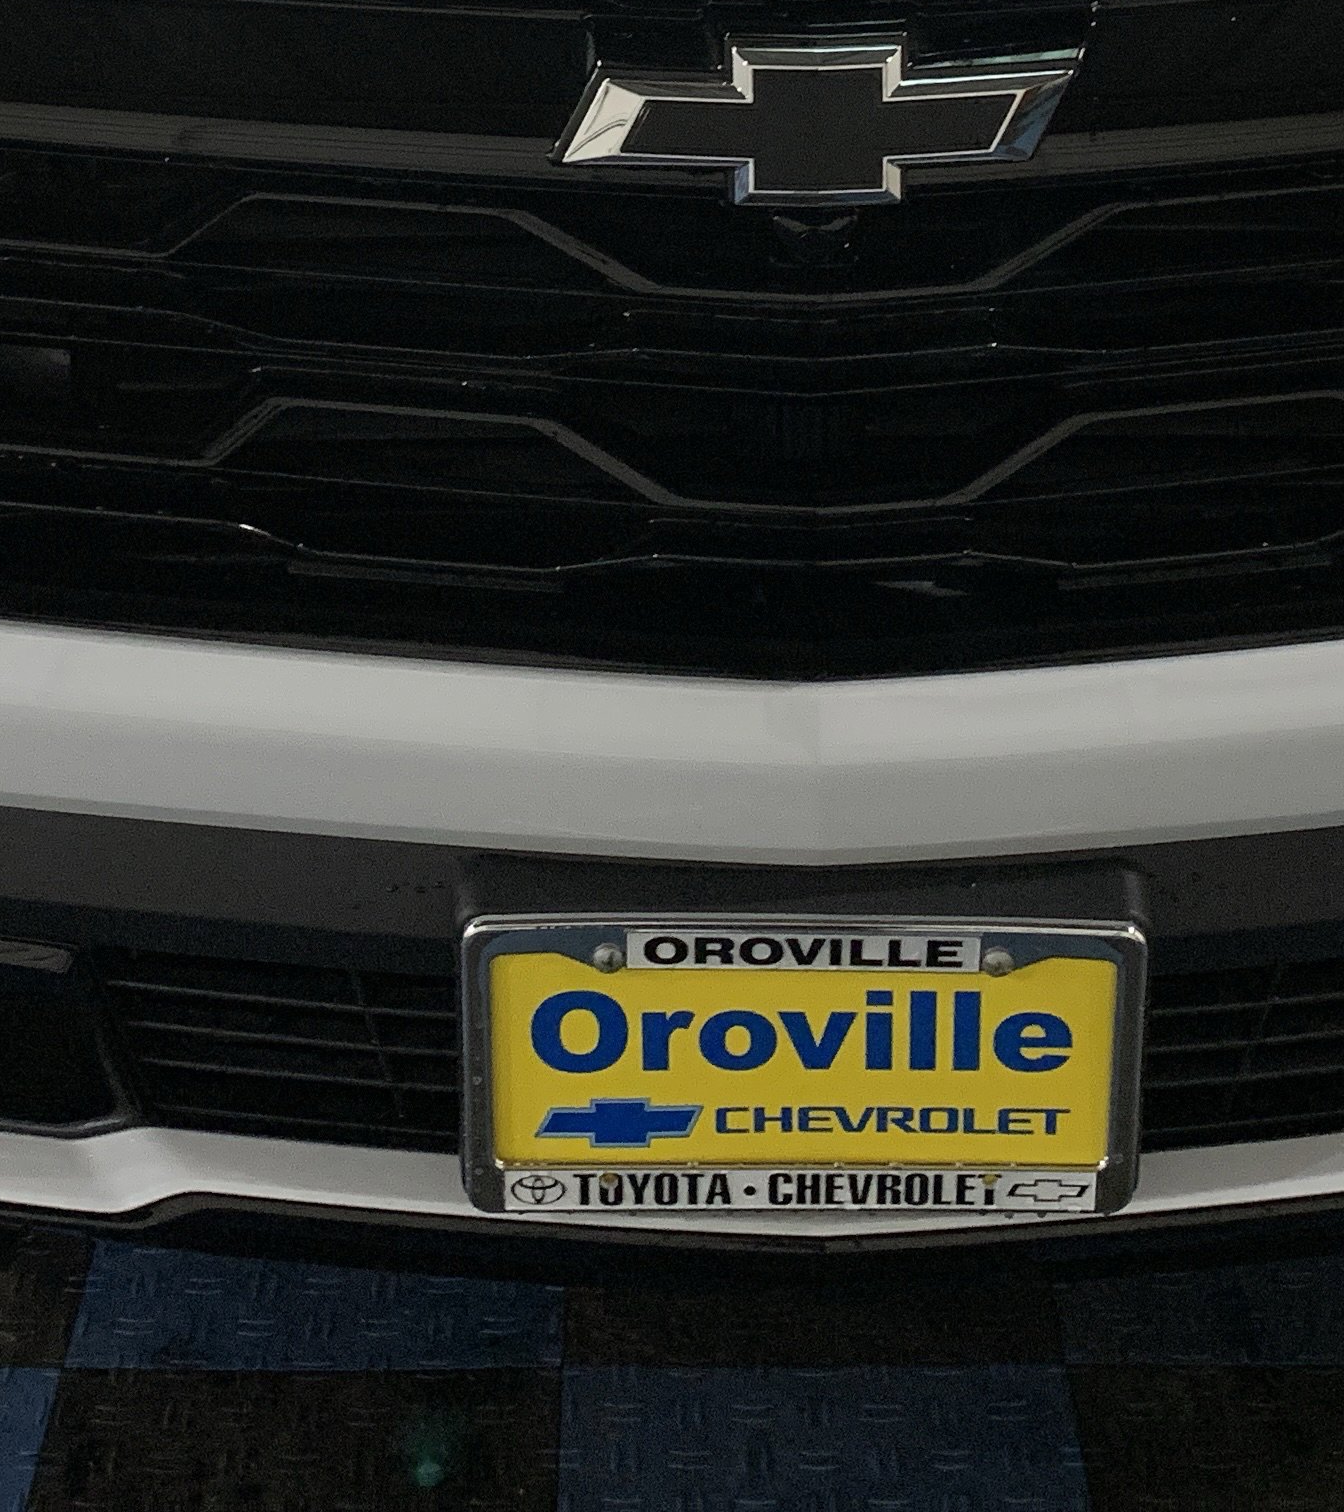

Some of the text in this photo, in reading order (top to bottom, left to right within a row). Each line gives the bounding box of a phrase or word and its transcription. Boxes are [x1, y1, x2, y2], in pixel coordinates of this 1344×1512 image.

[642, 936, 965, 969] OROVILLE
[530, 990, 1073, 1074] Oroville
[714, 1105, 1071, 1136] CHEVROLET
[573, 1172, 1001, 1208] TOYOTA CHEVROLET
